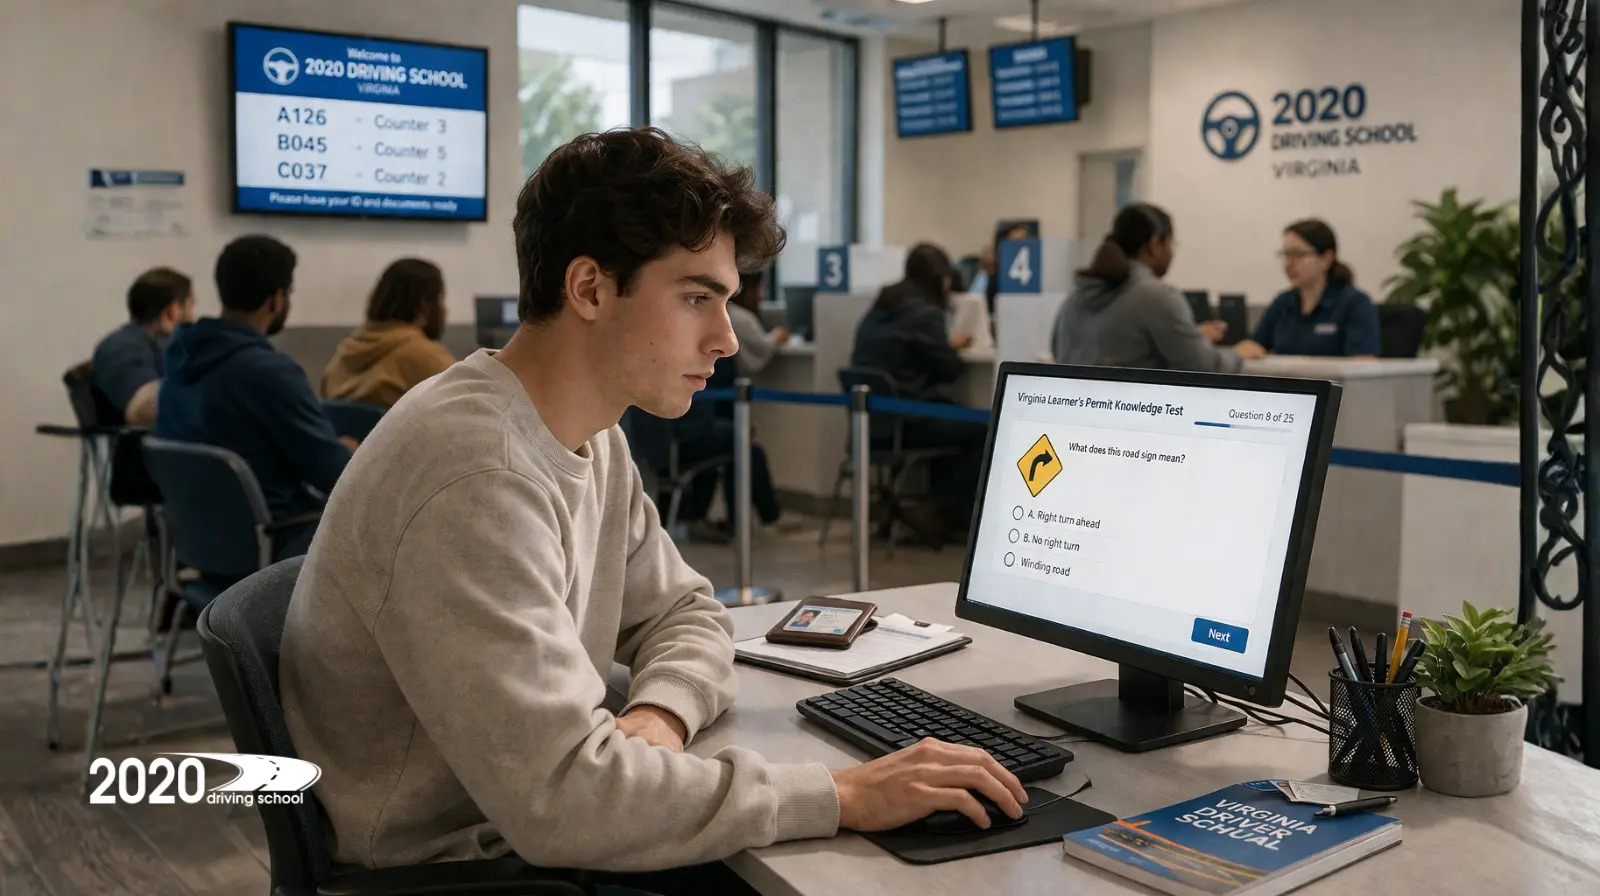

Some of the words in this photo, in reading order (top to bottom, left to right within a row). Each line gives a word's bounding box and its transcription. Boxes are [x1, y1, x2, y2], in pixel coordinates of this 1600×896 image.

[347, 47, 388, 61] Welcome
[390, 51, 401, 62] to
[305, 57, 344, 78] 2020
[347, 62, 406, 83] DRIVING
[409, 68, 468, 89] SCHOOL
[356, 82, 400, 96] VIRGINIA
[1272, 83, 1366, 125] 2020
[277, 106, 327, 126] A126
[374, 114, 429, 132] Counter
[437, 118, 447, 134] 3
[277, 134, 328, 153] B045
[374, 142, 429, 159] Counter
[437, 145, 447, 160] 5
[1271, 130, 1340, 151] DRIVING
[1344, 122, 1418, 147] SCHOOL
[277, 161, 327, 181] C037
[374, 168, 429, 186] Counter
[437, 171, 447, 187] 2
[1272, 157, 1361, 180] VIRGINIA
[269, 191, 301, 204] Please
[302, 194, 326, 205] have
[328, 196, 349, 208] your
[363, 197, 380, 208] and
[381, 197, 432, 210] documents
[823, 252, 844, 287] 3
[1008, 245, 1033, 287] 4
[1018, 392, 1046, 405] Virginia
[1048, 395, 1084, 408] Learner's
[1085, 398, 1113, 410] Permit
[1114, 400, 1163, 416] Knowledge
[1165, 404, 1184, 416] Test
[1228, 408, 1264, 422] Question
[1265, 411, 1272, 422] 8
[1272, 412, 1283, 423] of
[1283, 413, 1295, 424] 25
[1068, 442, 1088, 454] What
[1088, 444, 1106, 455] does
[1107, 446, 1121, 457] this
[1122, 448, 1139, 459] road
[1141, 450, 1157, 462] sign
[1158, 453, 1186, 464] mean?
[1028, 509, 1035, 519] A.
[1037, 510, 1057, 523] Right
[1058, 515, 1075, 524] turn
[1075, 517, 1101, 529] ahead
[1023, 533, 1031, 543] B.
[1032, 534, 1042, 545] No
[1044, 537, 1062, 549] right
[1063, 541, 1080, 552] turn
[1021, 557, 1051, 575] Winding
[1052, 567, 1071, 576] road
[1208, 628, 1231, 643] Next
[1193, 806, 1293, 839] DRIVER
[1215, 798, 1318, 835] VIRGINIA
[1174, 813, 1283, 851] SCHUAL
